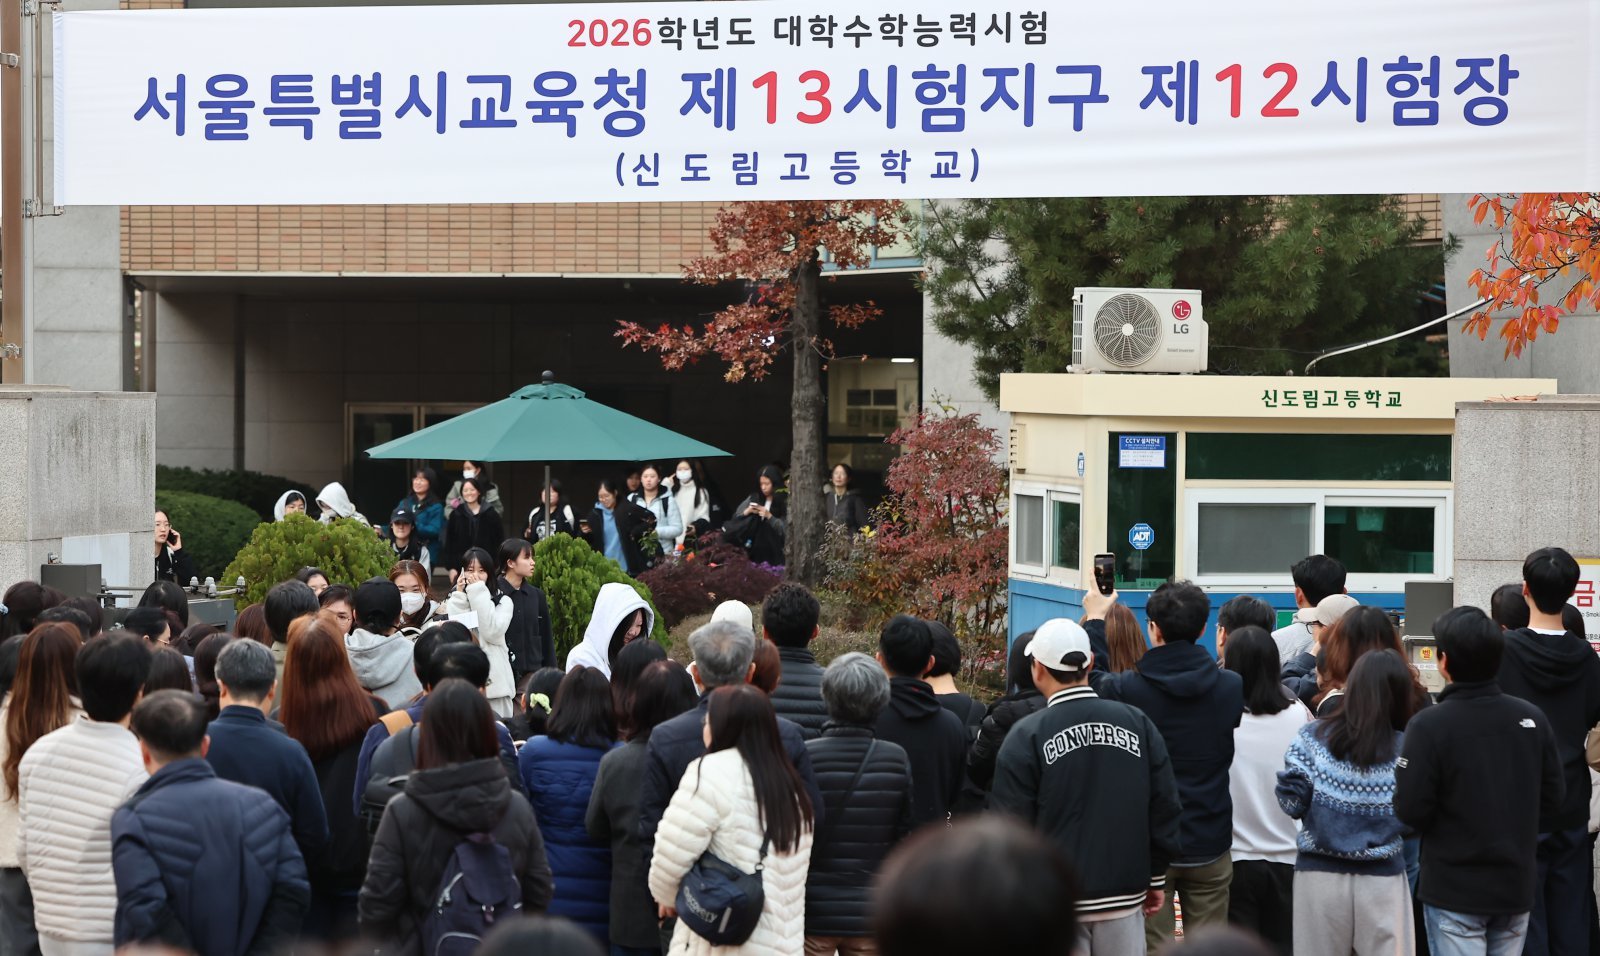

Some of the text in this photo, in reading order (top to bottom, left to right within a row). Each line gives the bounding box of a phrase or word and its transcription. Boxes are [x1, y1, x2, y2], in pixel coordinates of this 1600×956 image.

[567, 10, 1048, 51] 2026학년도 대학수학능력시험
[133, 53, 1520, 141] 서울특별시교육청 제13시험지구 제12시험장
[1173, 323, 1189, 334] LG
[1261, 389, 1402, 409] 신도림고등학교
[1133, 531, 1150, 542] ADT
[1043, 722, 1141, 765] CONVERSE
